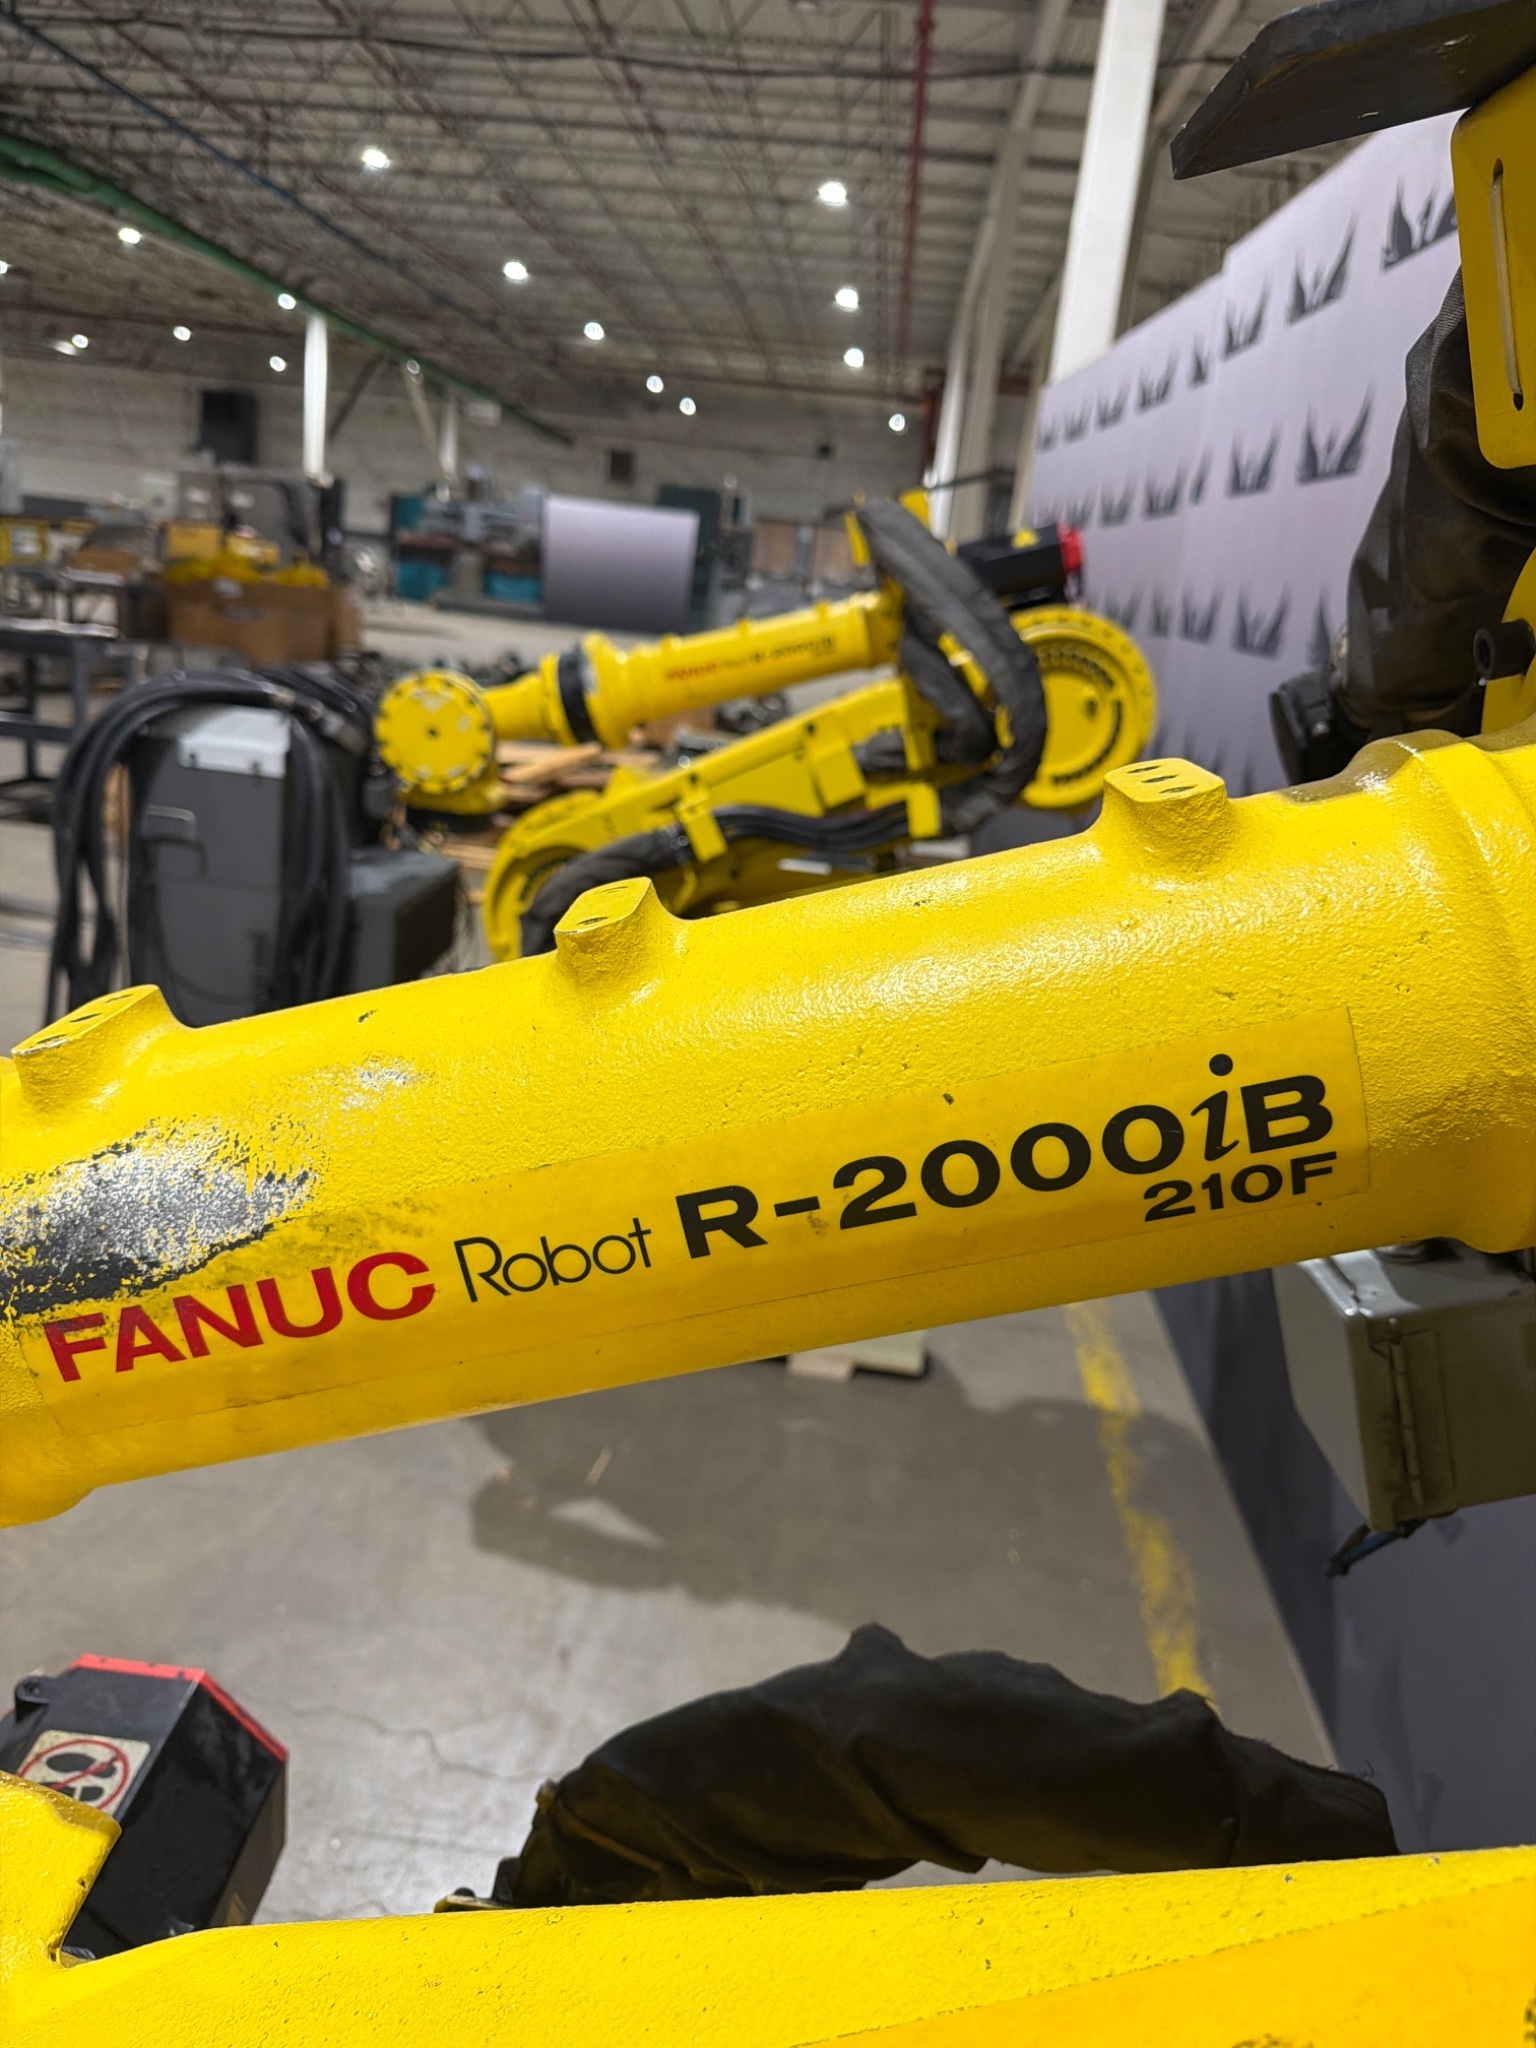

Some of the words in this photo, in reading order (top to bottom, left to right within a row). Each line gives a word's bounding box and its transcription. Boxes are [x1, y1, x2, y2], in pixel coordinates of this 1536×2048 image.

[43, 1252, 436, 1382] FANUC
[454, 1217, 653, 1303] Robot
[676, 1053, 1334, 1259] R-2000iB
[1143, 1151, 1337, 1222] 210F
